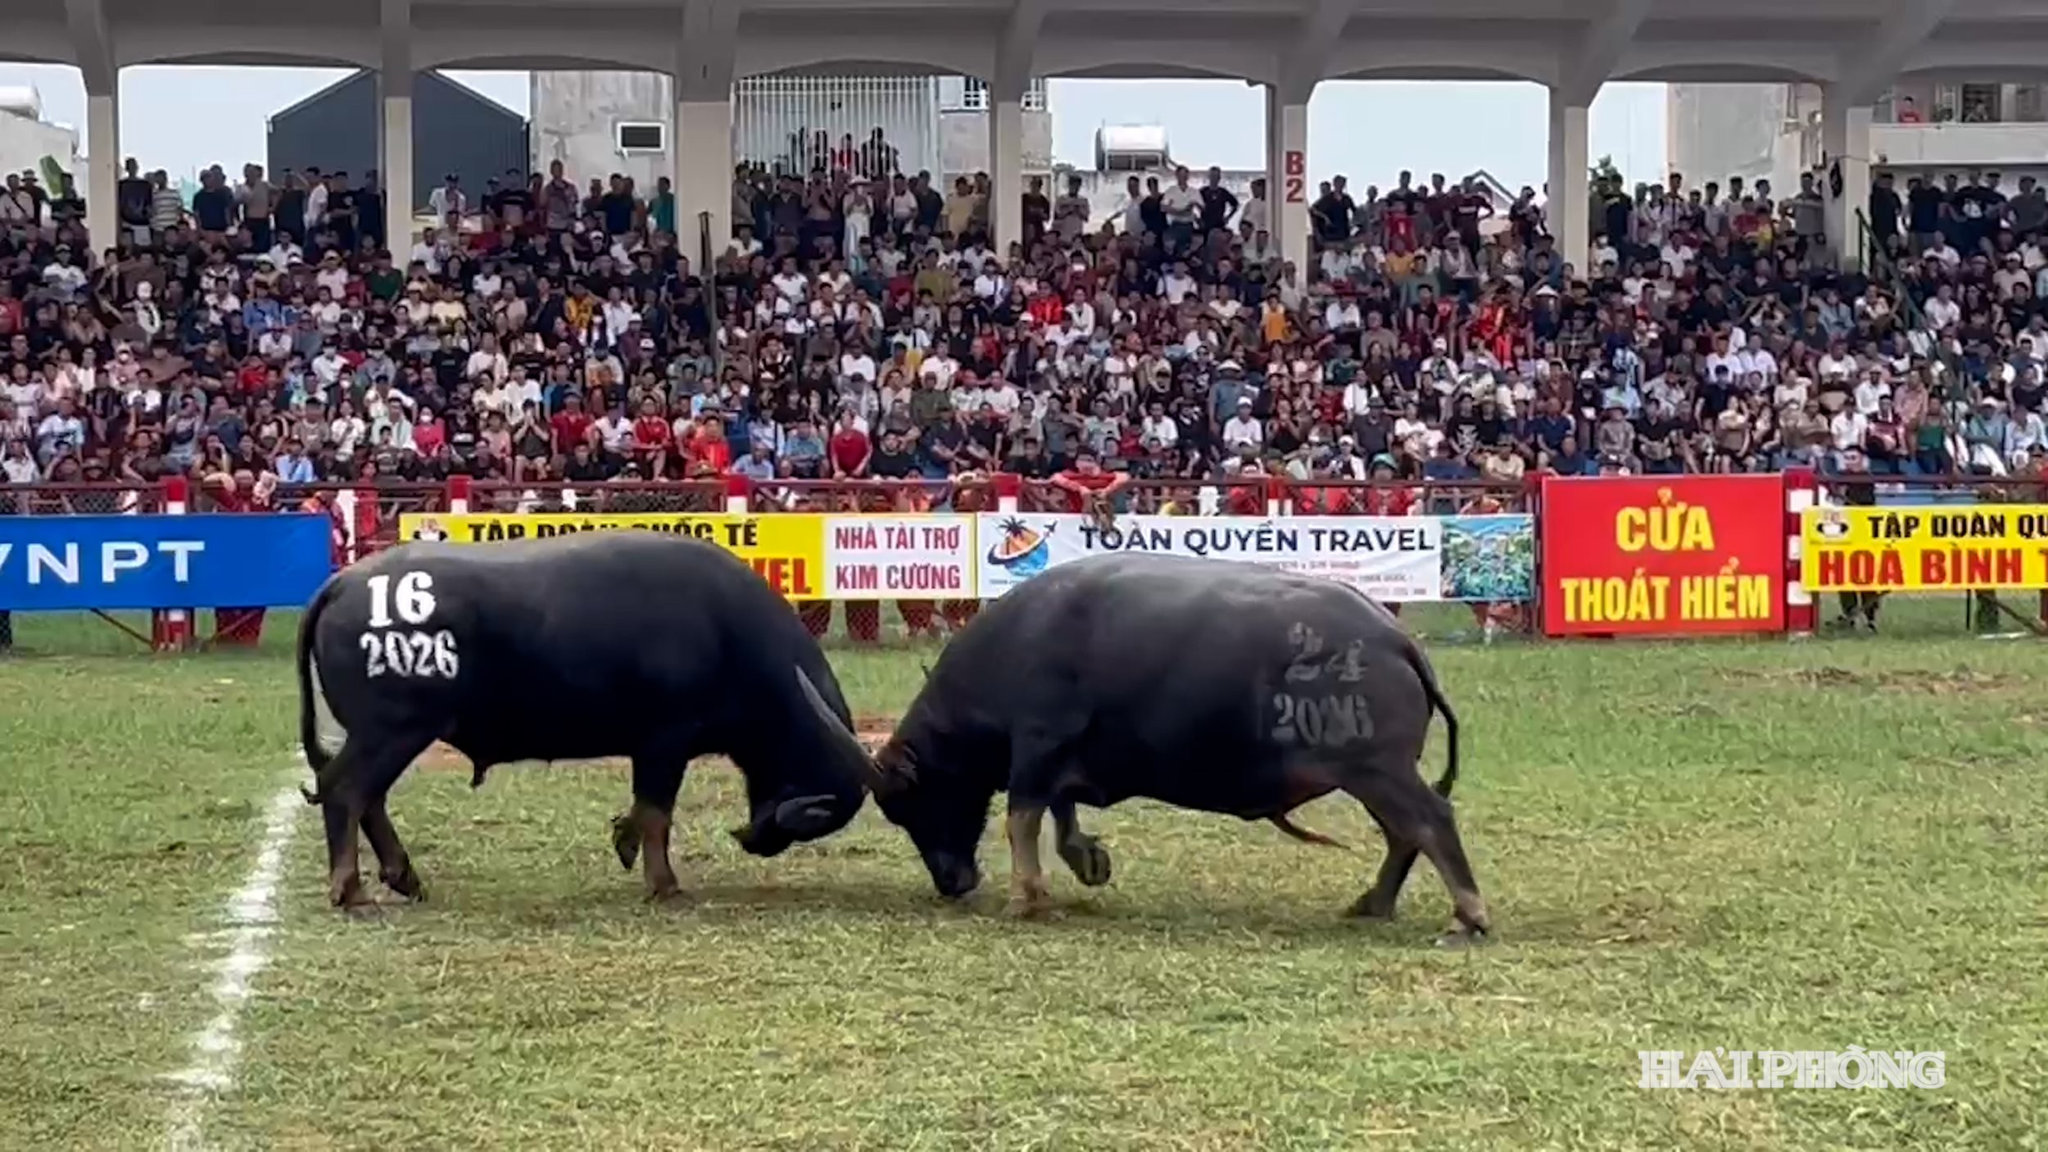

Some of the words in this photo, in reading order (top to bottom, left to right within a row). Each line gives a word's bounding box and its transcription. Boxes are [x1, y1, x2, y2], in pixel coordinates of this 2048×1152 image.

[1285, 150, 1304, 203] B2
[724, 517, 758, 546] TẾ
[834, 521, 878, 550] NHÀ
[885, 520, 915, 550] TÀI
[922, 524, 961, 556] TRỢ
[1079, 521, 1173, 550] TOÀN
[1308, 528, 1435, 551] TRAVEL
[1615, 486, 1716, 552] CỬA
[1868, 512, 1920, 543] TẬP
[0, 541, 206, 584] NPT
[835, 564, 878, 590] KIM
[886, 562, 961, 590] CƯƠNG
[1920, 542, 2023, 584] BÌNH
[367, 571, 437, 628] 16
[1560, 566, 1671, 622] THOÁT
[1680, 556, 1770, 621] HIỂM
[359, 629, 460, 680] 2026
